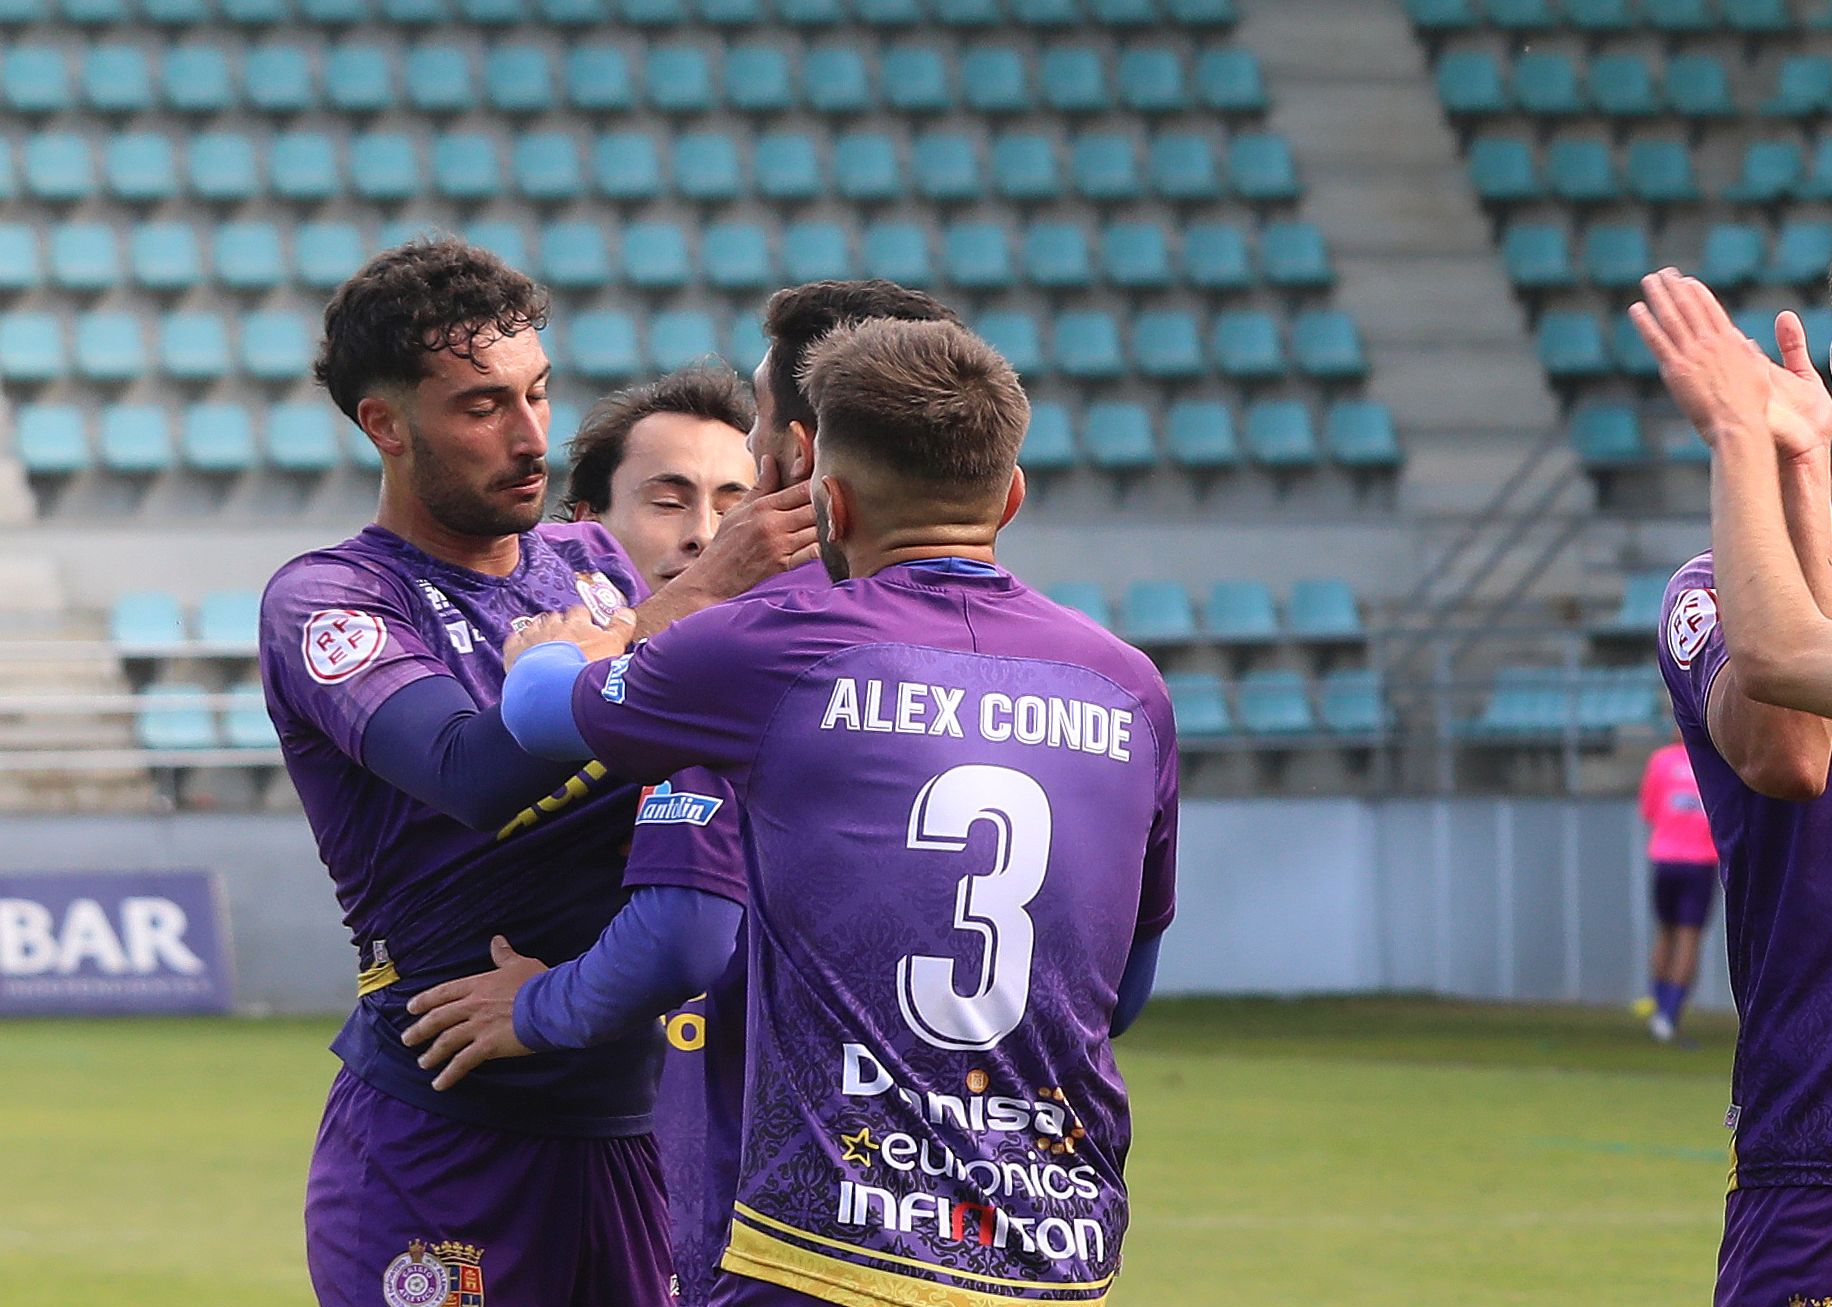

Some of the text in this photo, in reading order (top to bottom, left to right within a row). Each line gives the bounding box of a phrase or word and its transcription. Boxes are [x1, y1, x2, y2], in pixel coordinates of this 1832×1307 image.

[820, 678, 1133, 762] ALEX CONDE
[897, 764, 1054, 1052] 3
